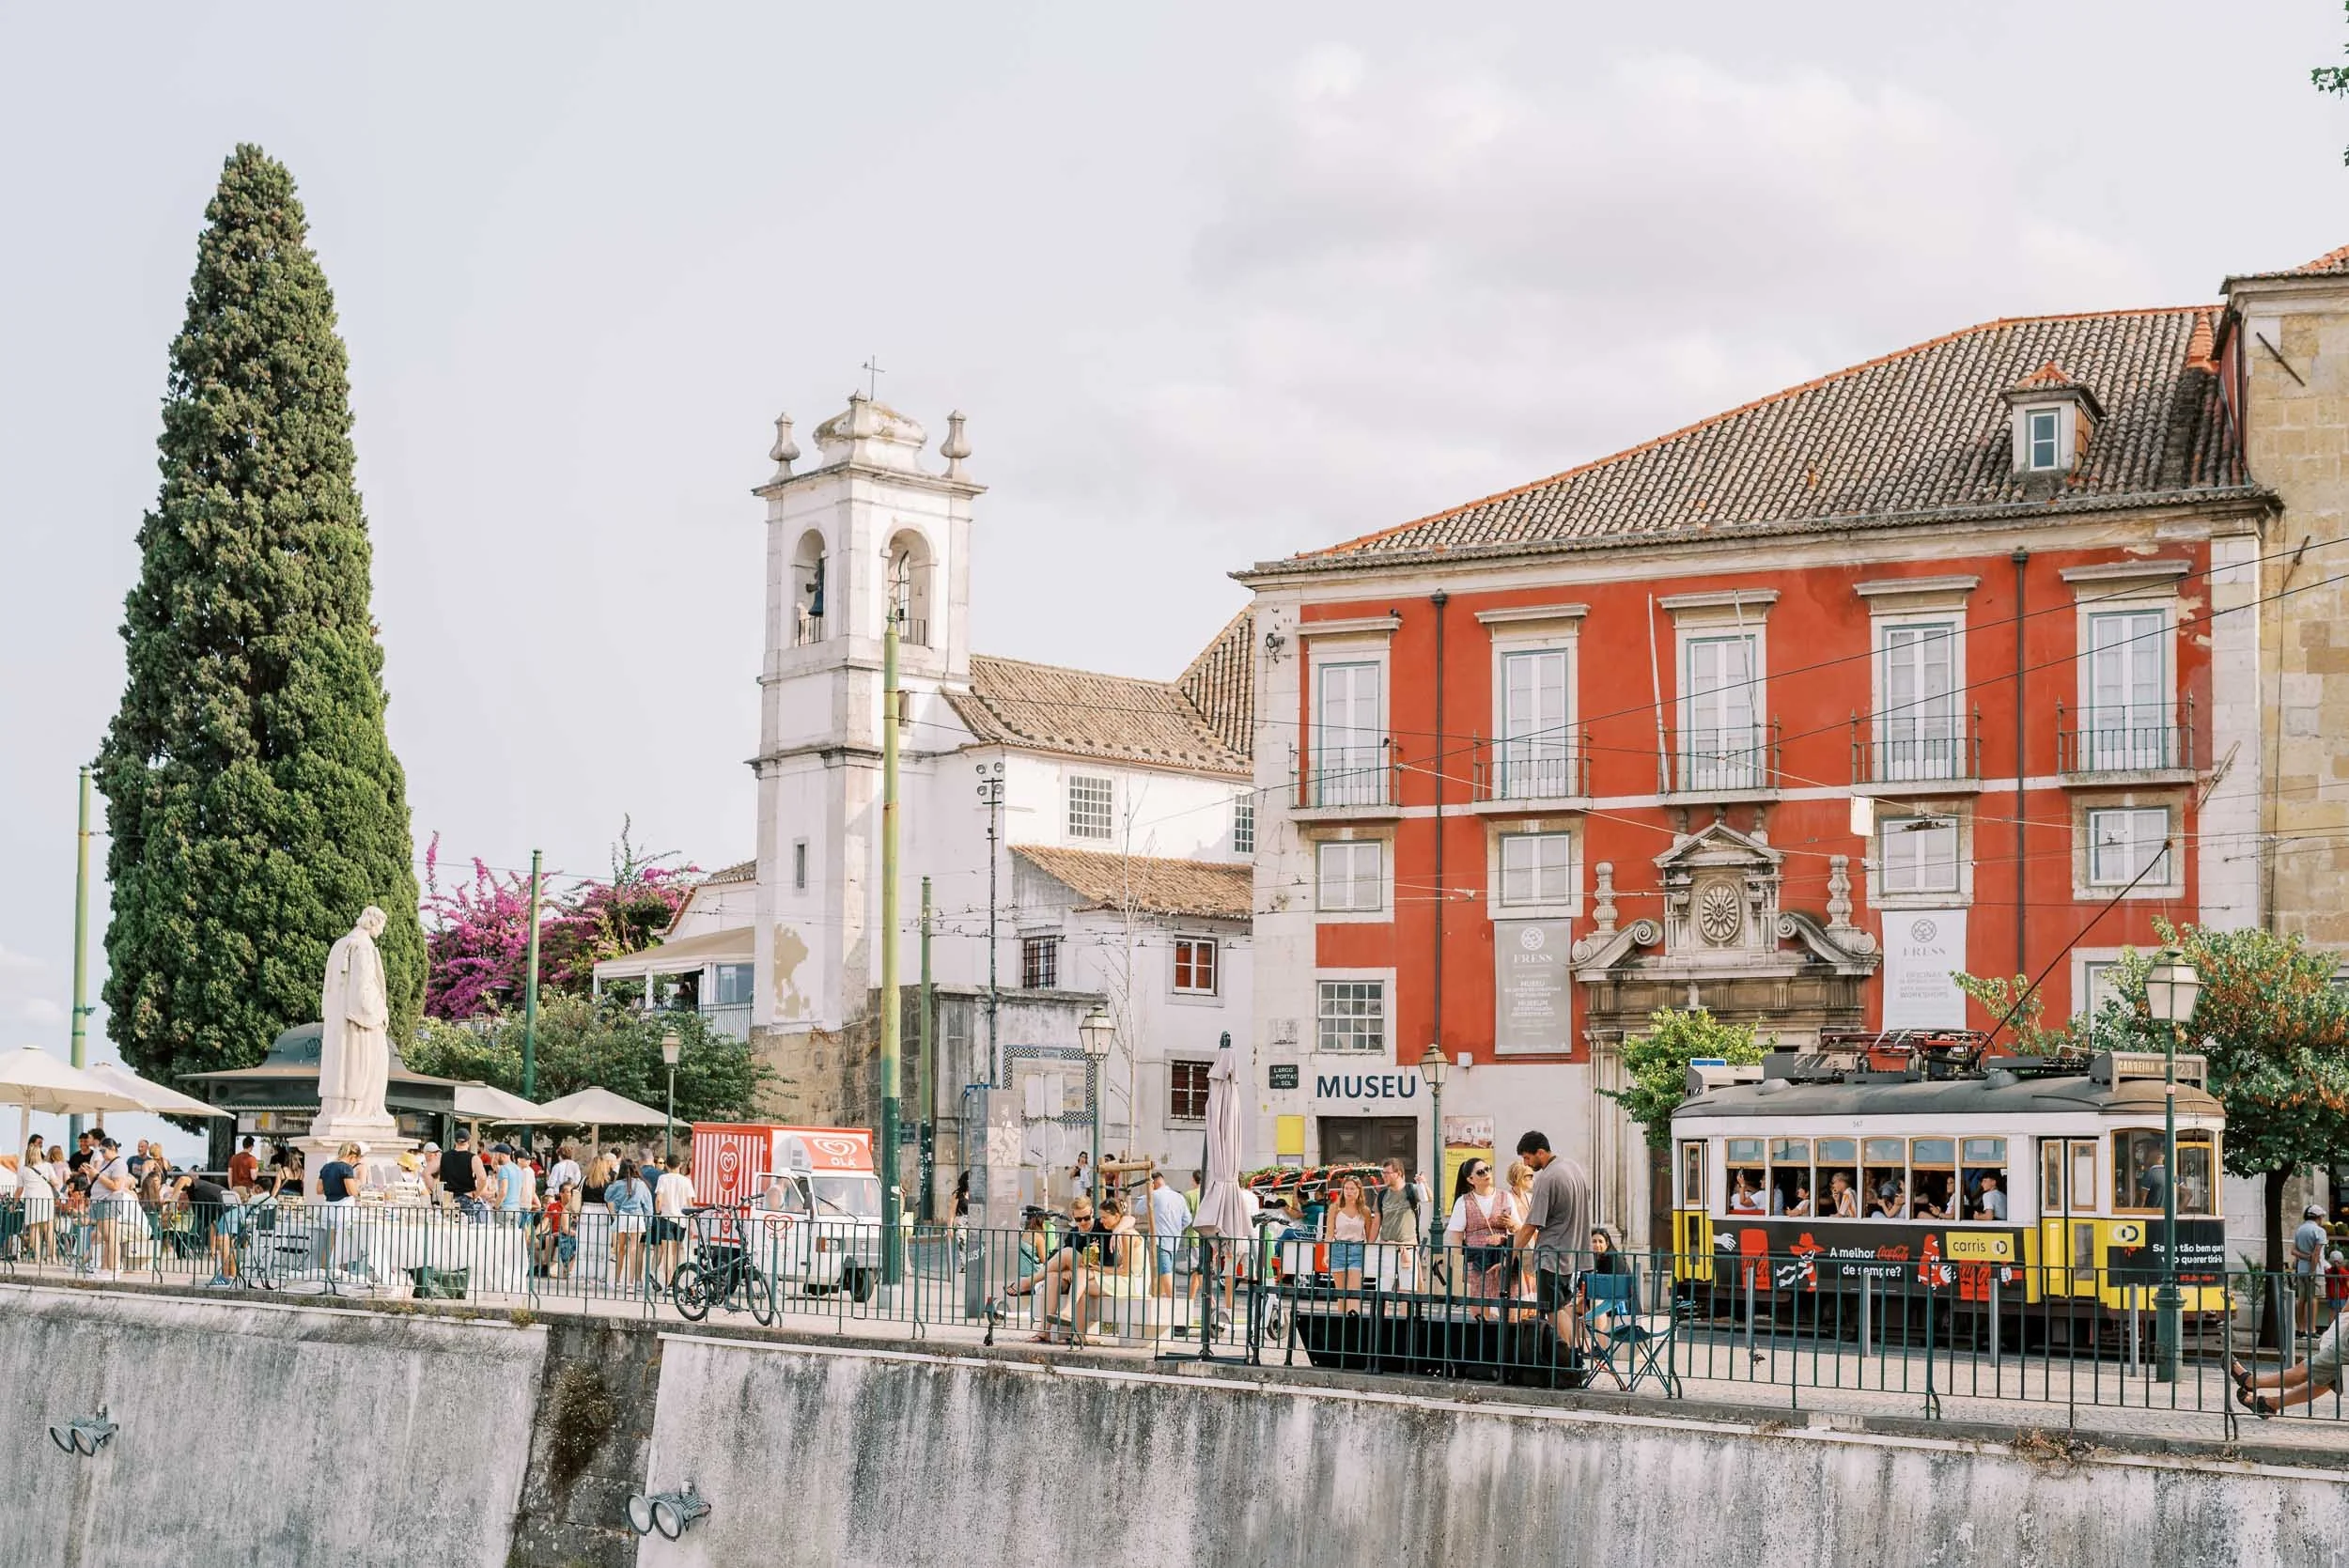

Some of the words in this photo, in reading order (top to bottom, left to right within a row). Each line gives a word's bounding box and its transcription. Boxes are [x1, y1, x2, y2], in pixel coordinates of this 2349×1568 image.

[1317, 1076, 1416, 1098] MUSEU
[1952, 1238, 1986, 1252] carris
[2179, 1243, 2195, 1252] tão
[2195, 1243, 2211, 1252] bem
[1829, 1247, 1837, 1258] A
[1839, 1247, 1875, 1259] melhor
[2181, 1256, 2207, 1265] querer
[1842, 1264, 1856, 1275] de
